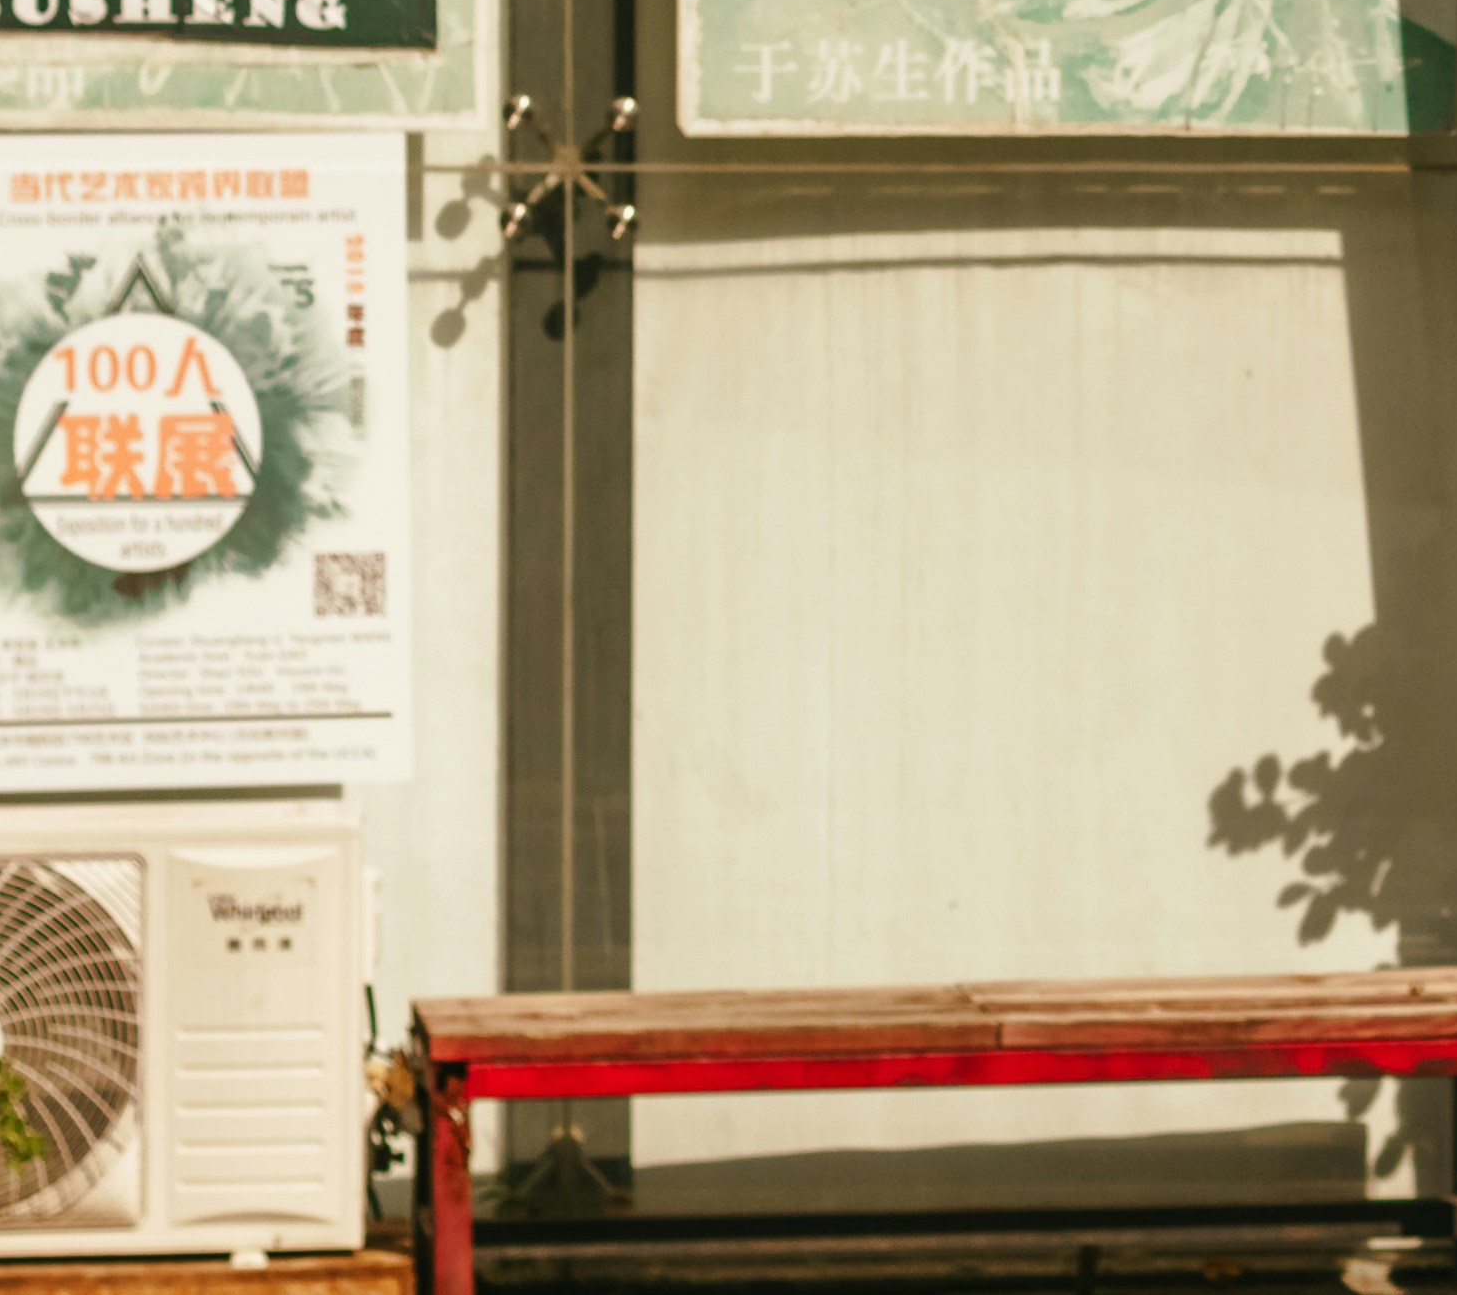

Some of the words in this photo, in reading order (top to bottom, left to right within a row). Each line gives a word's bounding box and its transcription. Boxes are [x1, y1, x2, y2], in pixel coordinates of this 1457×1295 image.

[735, 39, 1062, 105] 于苏生作品
[54, 337, 222, 397] 100人
[58, 413, 237, 499] 联展
